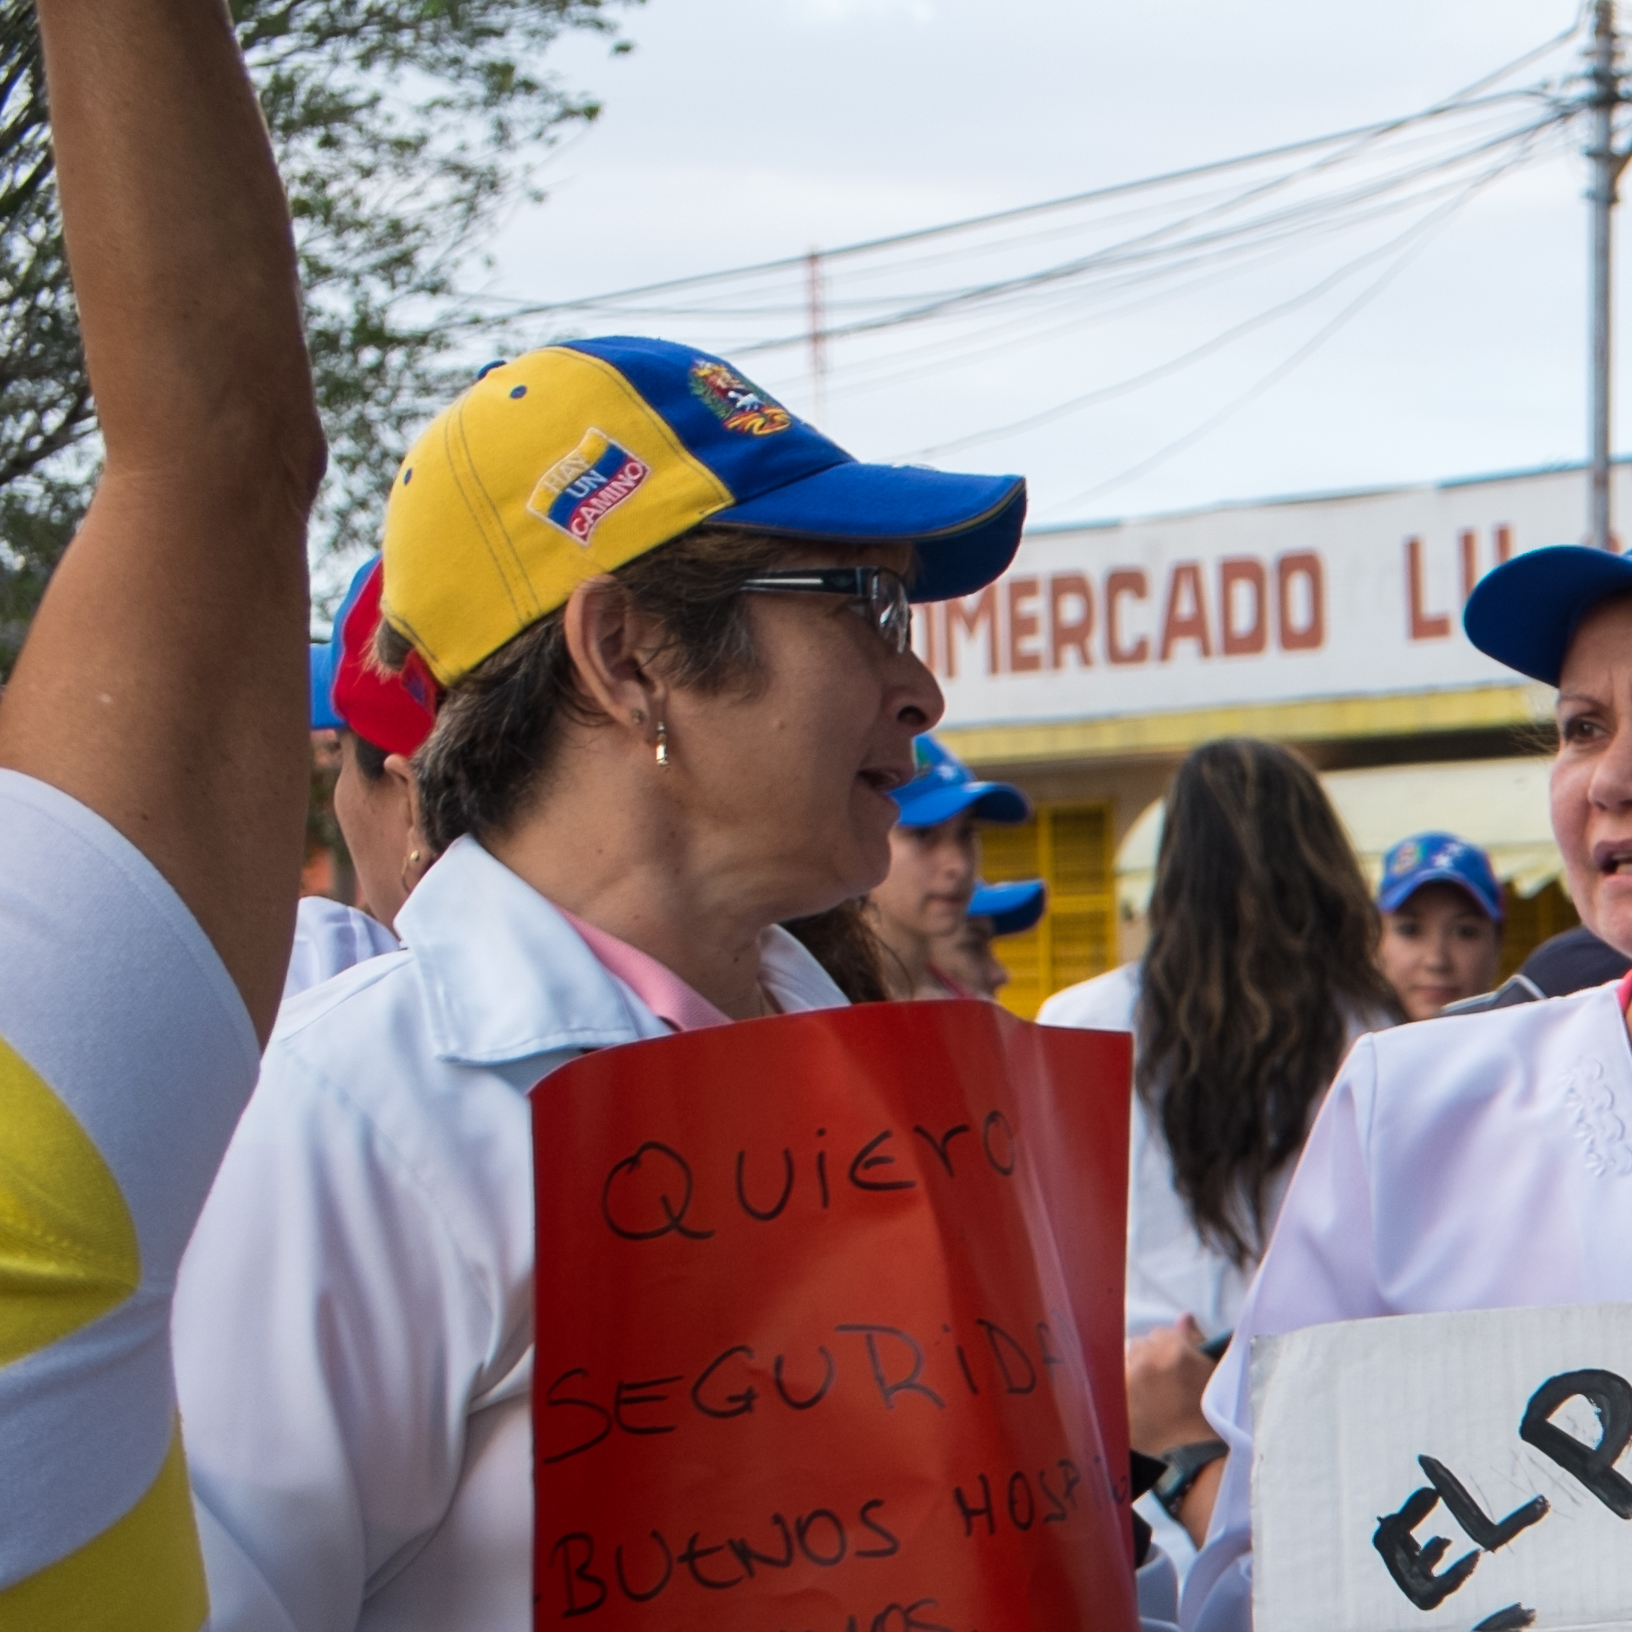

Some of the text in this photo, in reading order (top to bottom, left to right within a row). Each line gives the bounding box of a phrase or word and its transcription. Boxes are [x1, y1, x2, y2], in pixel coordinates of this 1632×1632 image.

[543, 451, 591, 494] HAY
[565, 468, 608, 499] UN
[570, 461, 643, 537] CAMINO
[551, 1499, 900, 1618] BUENOS
[1373, 1453, 1551, 1610] EL
